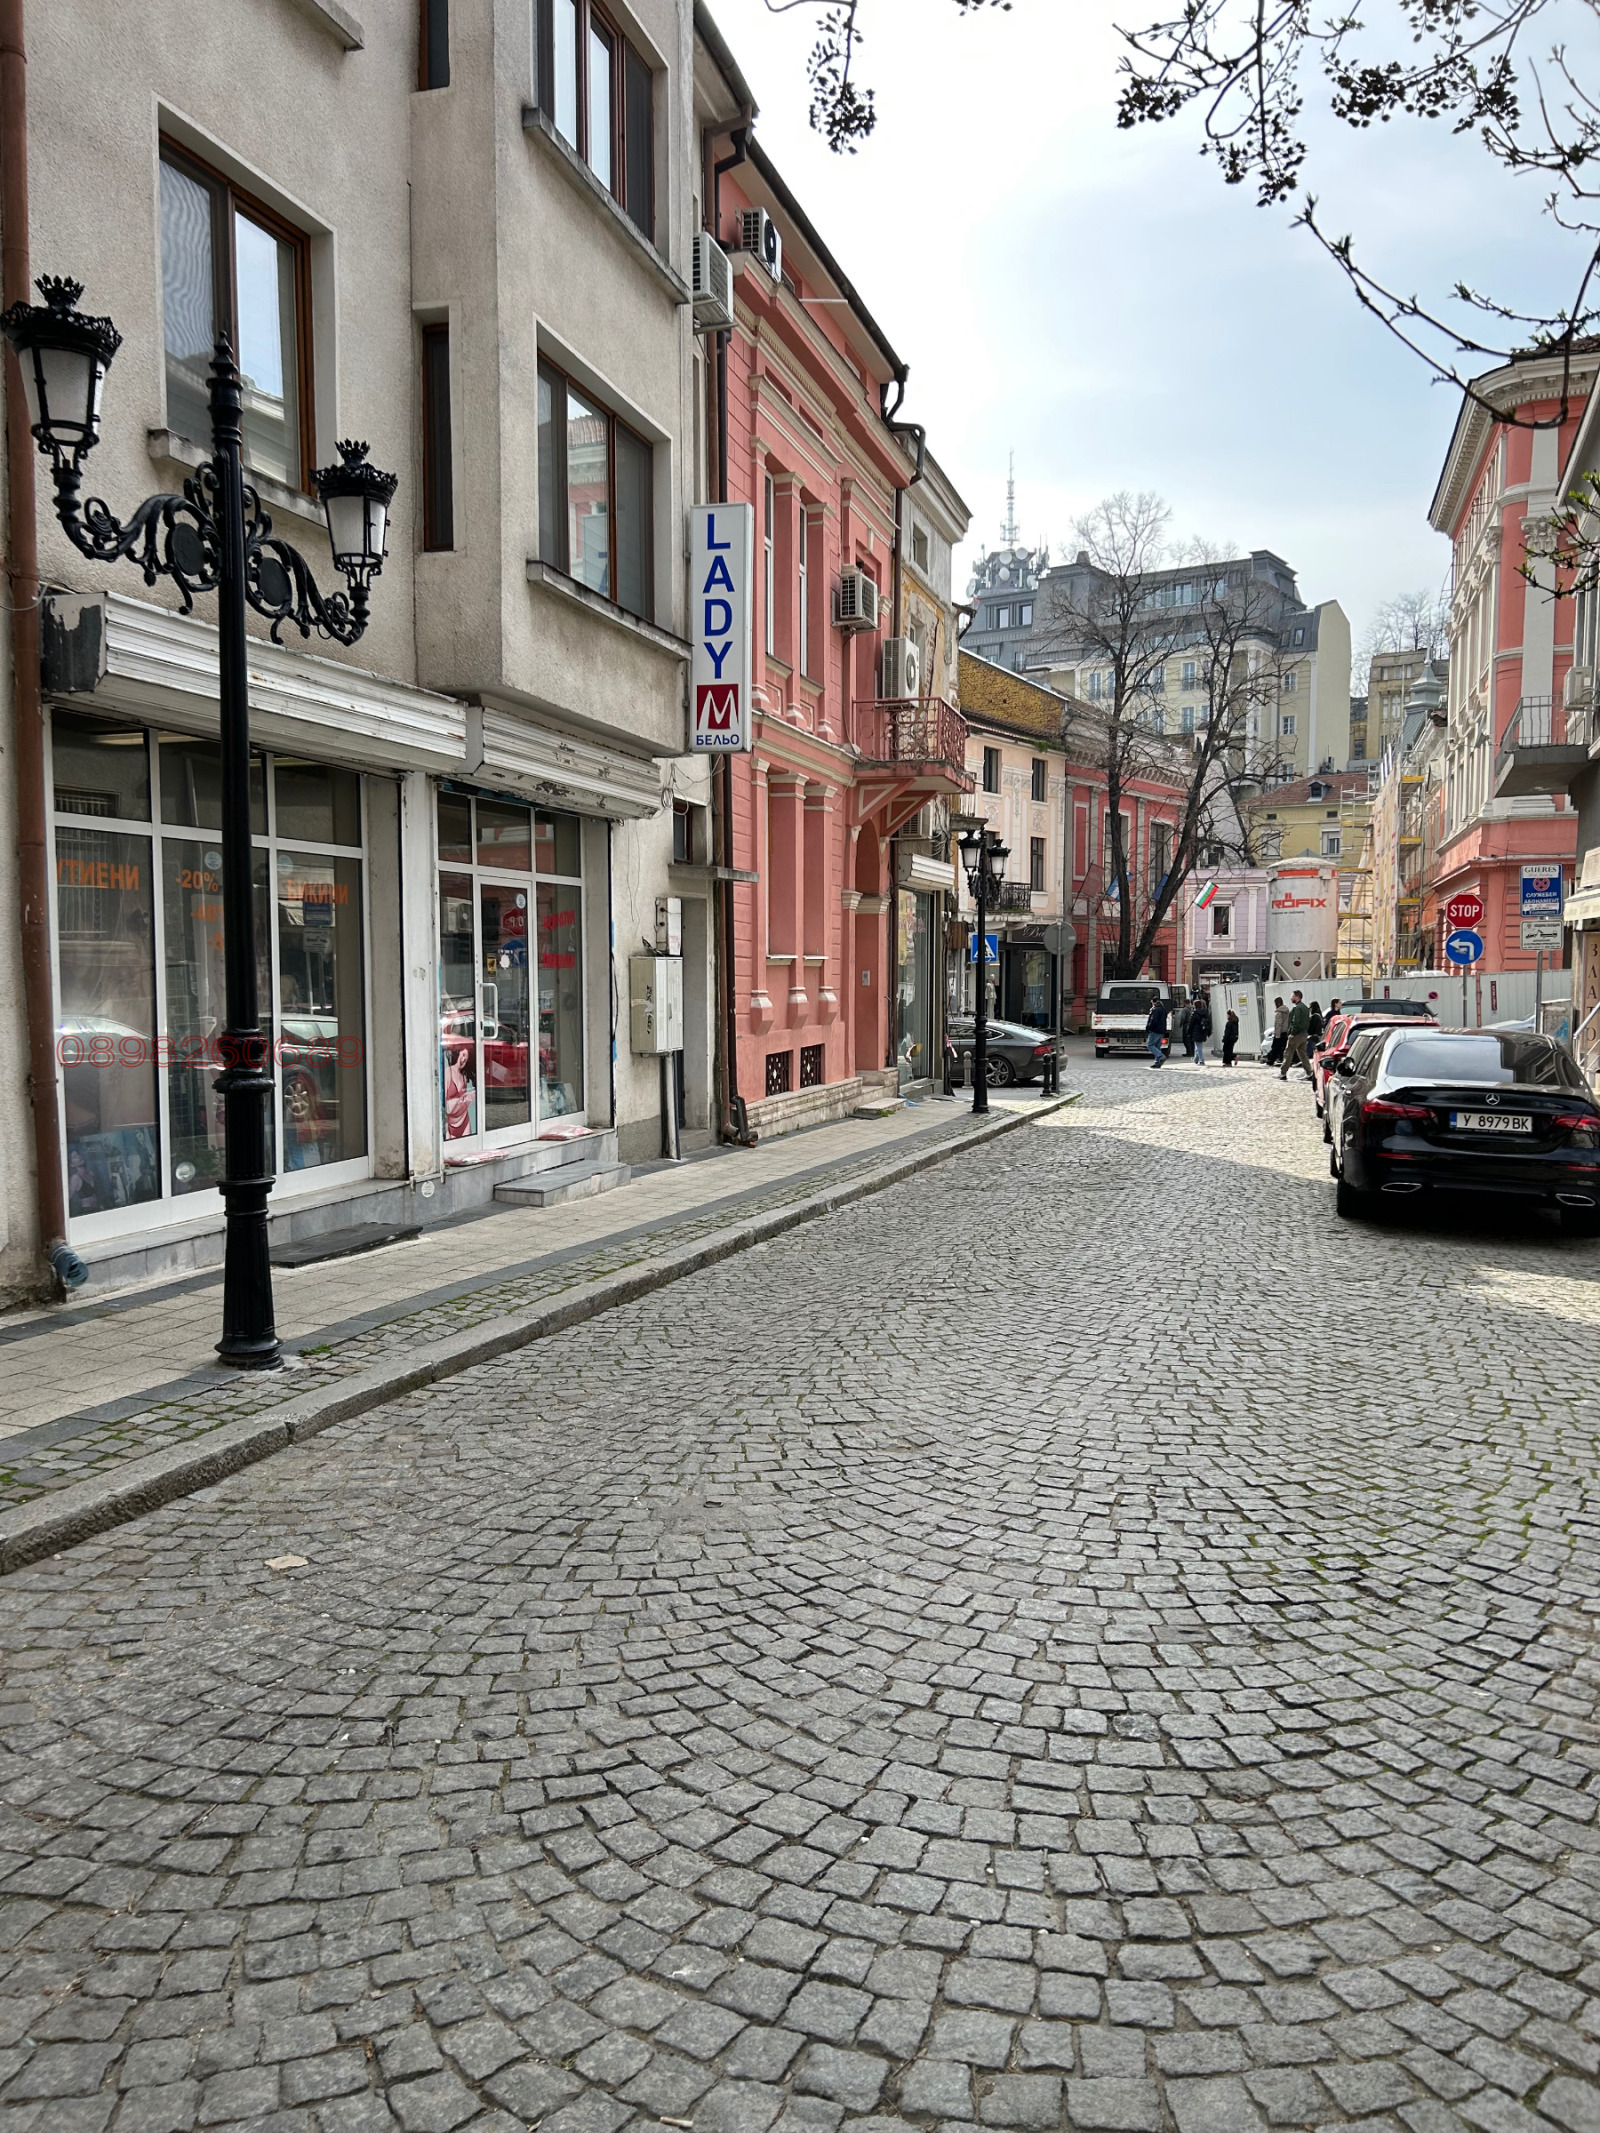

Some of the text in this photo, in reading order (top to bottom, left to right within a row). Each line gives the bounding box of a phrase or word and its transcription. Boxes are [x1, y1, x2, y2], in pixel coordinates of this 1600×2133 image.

[703, 513, 736, 680] LADY
[696, 734, 740, 746] БЕЛЬО
[176, 868, 219, 892] -20%
[1449, 904, 1480, 917] STOP
